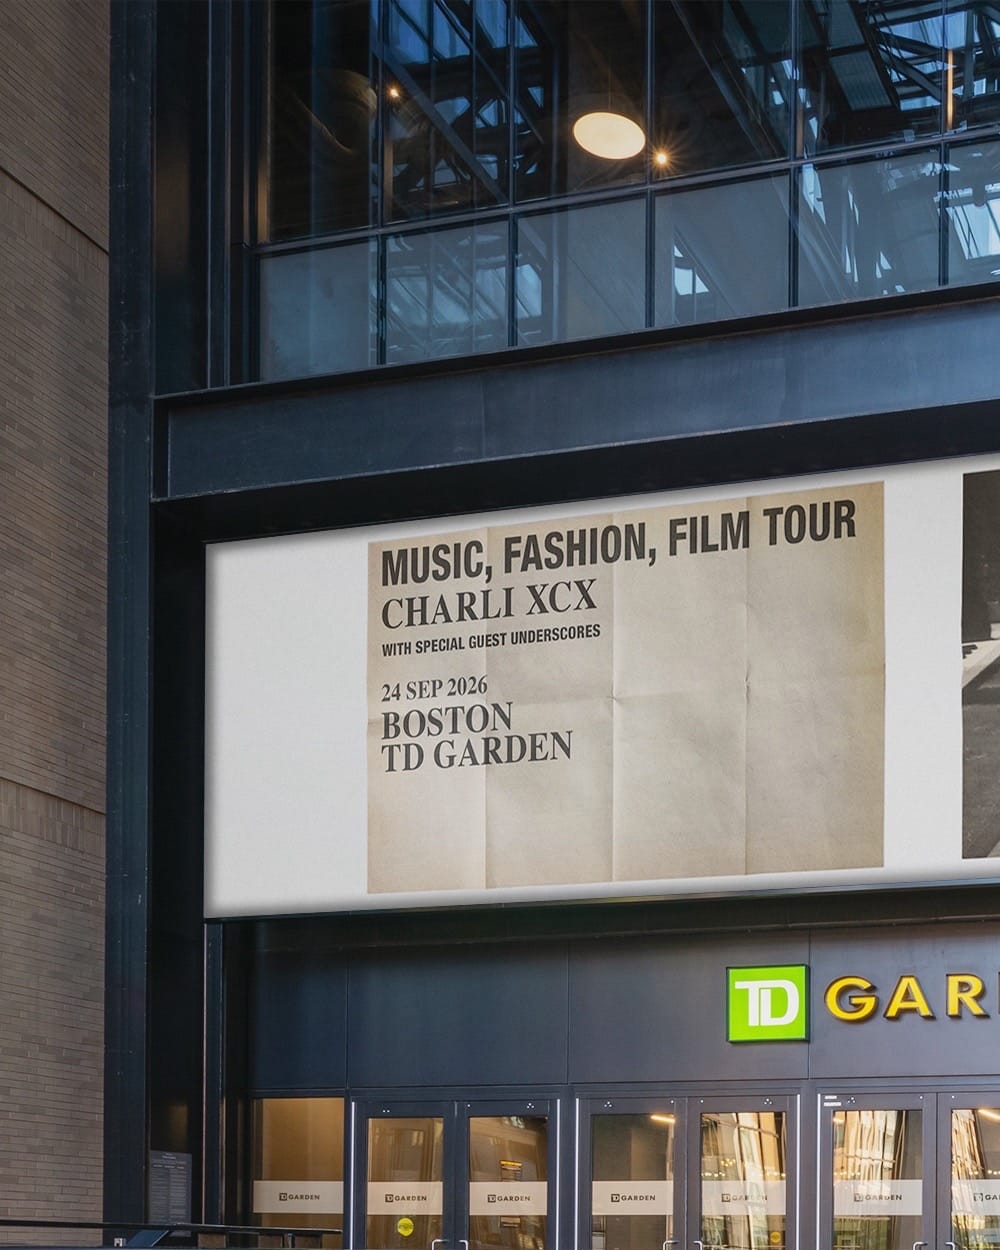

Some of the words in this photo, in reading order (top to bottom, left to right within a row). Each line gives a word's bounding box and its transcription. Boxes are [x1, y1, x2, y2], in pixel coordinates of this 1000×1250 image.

[382, 540, 492, 586] MUSIC,
[504, 522, 656, 573] FASHION,
[669, 511, 750, 556] FILM
[763, 500, 856, 546] TOUR
[381, 587, 515, 629] CHARLI
[526, 578, 597, 616] XCX
[382, 641, 412, 657] WITH
[415, 636, 465, 654] SPECIAL
[468, 632, 507, 649] GUEST
[510, 623, 601, 646] UNDERSCORES
[381, 682, 401, 702] 24
[406, 679, 443, 700] SEP
[447, 674, 488, 697] 2026
[381, 701, 513, 740] BOSTON
[381, 742, 424, 773] TD
[434, 730, 573, 769] GARDEN
[734, 978, 800, 1028] TD
